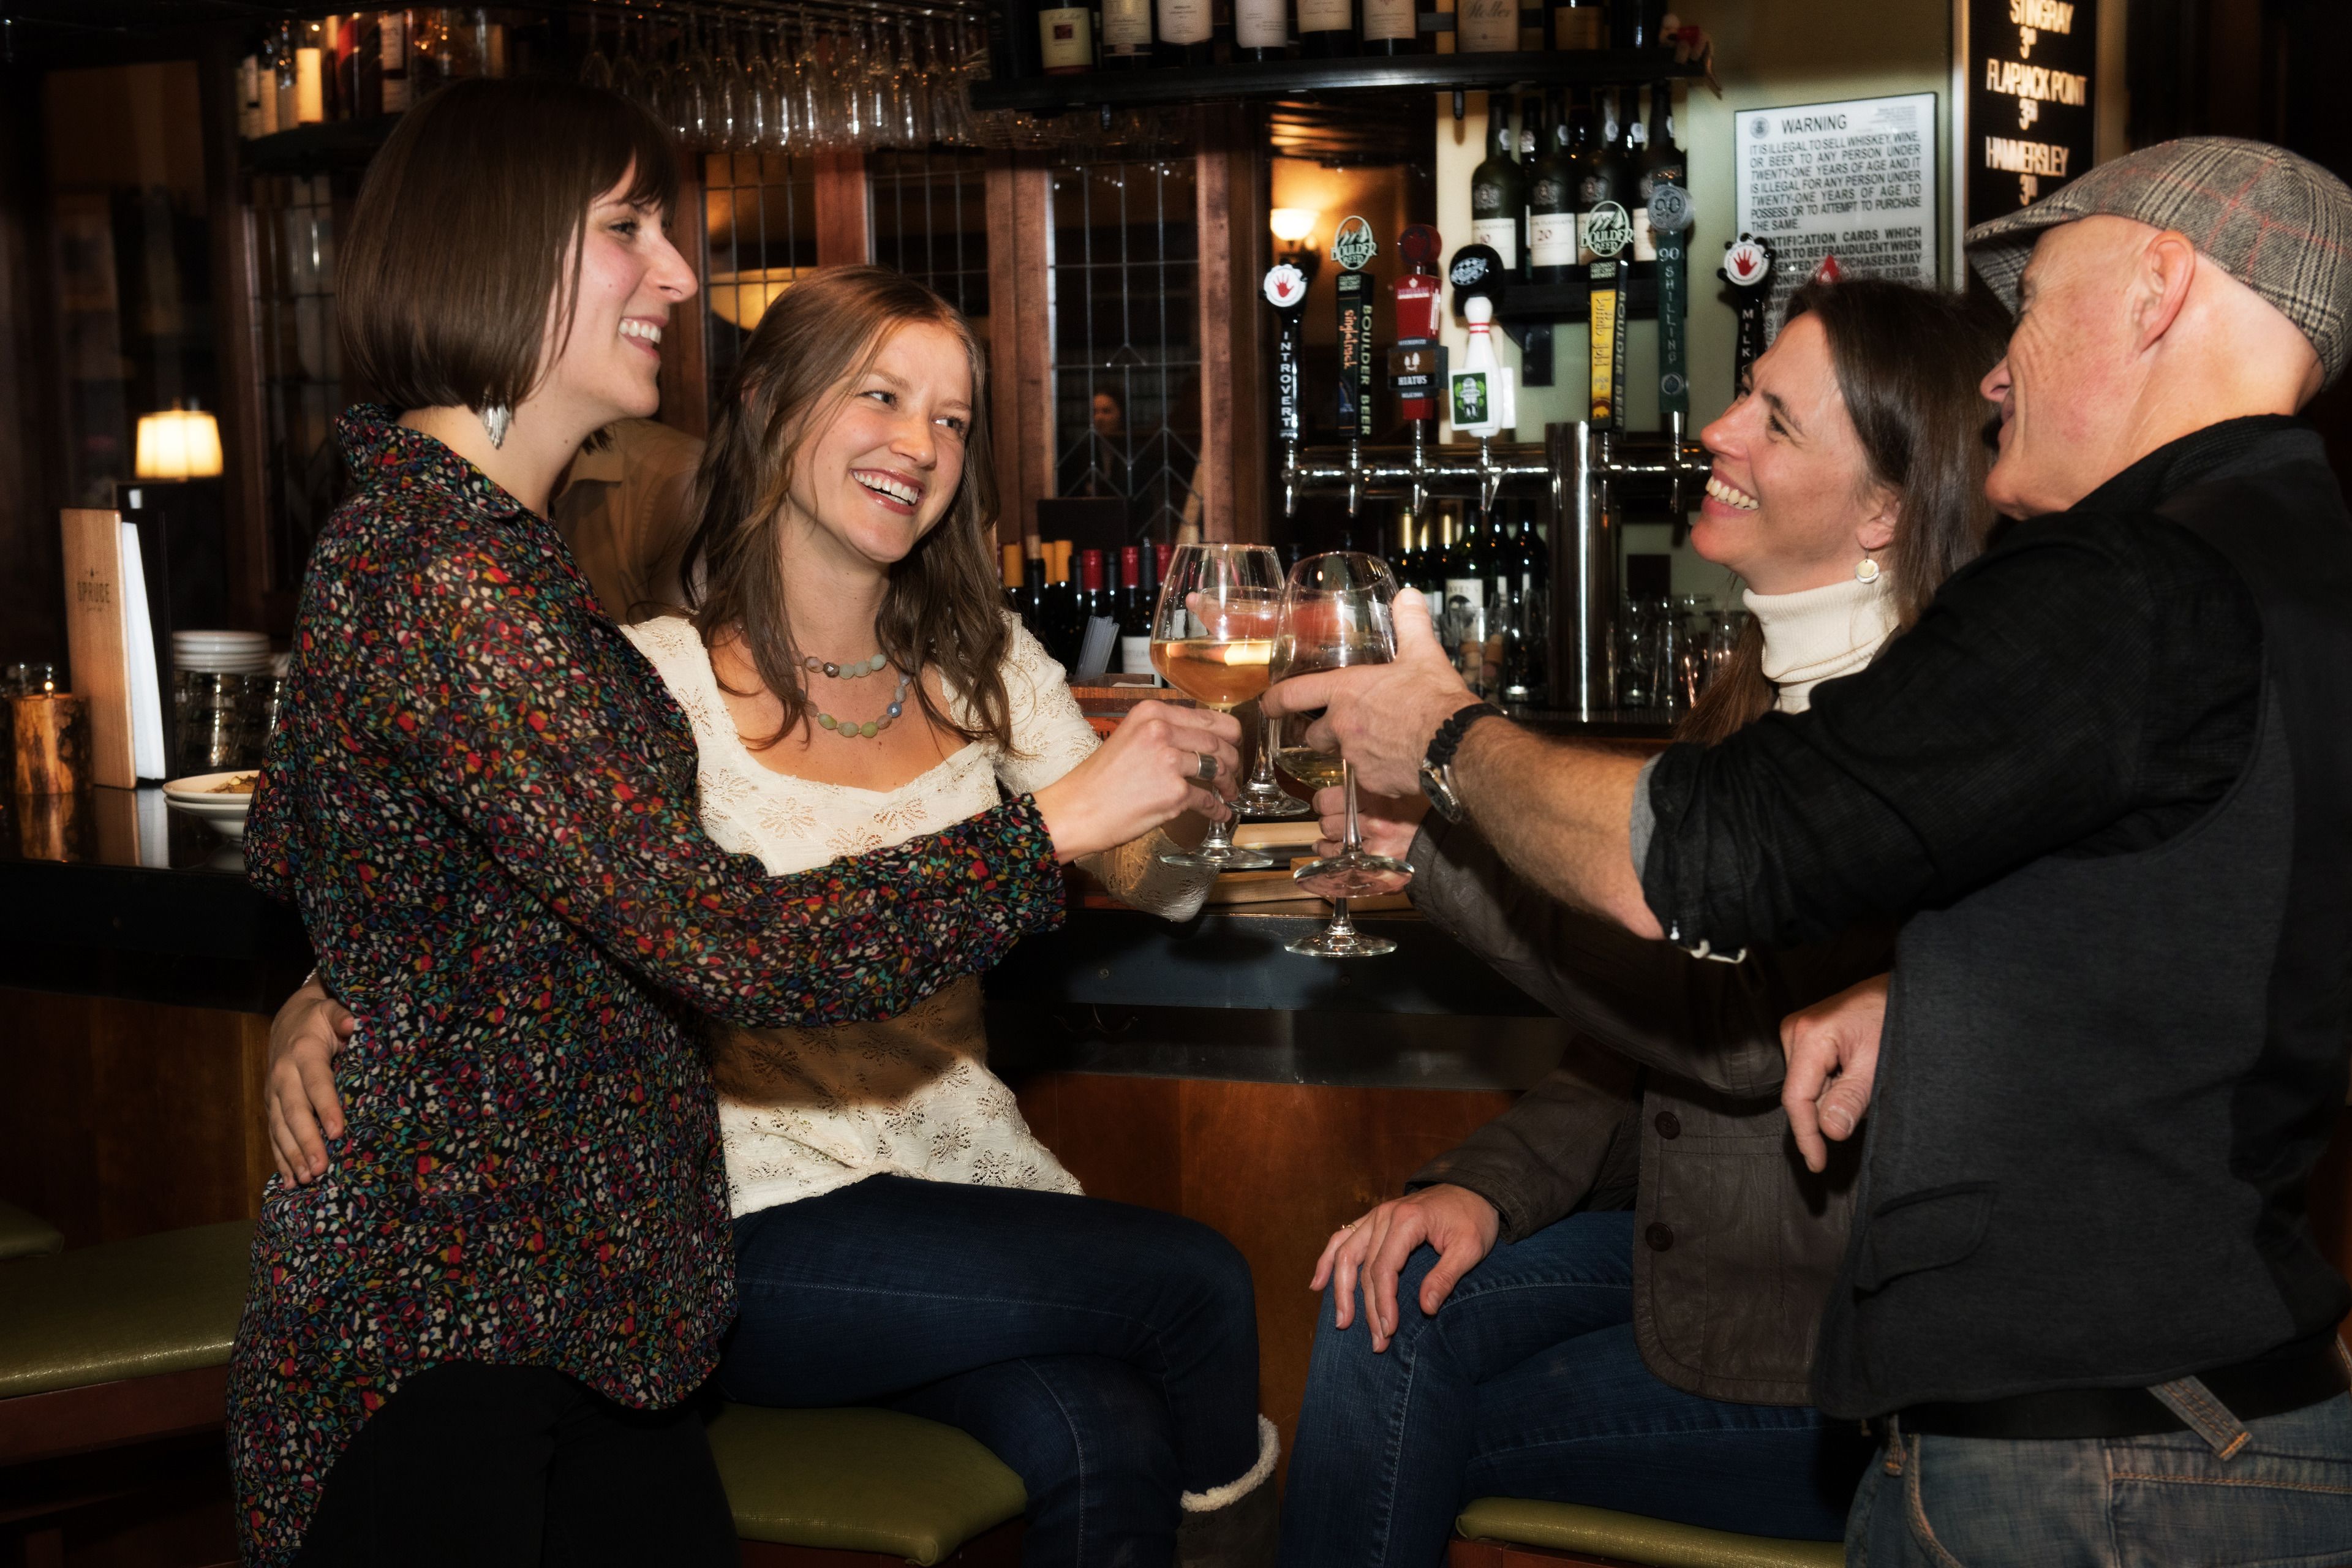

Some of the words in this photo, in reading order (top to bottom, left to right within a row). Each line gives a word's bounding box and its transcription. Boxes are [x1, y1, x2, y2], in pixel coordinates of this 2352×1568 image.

[2010, 0, 2075, 35] STINGRAY
[1986, 58, 2051, 100] FLAPJACK
[2050, 70, 2087, 107] POINT
[1781, 114, 1847, 134] WARNING
[1750, 145, 1757, 156] IT
[1758, 144, 1767, 155] IS
[1768, 141, 1807, 154] ILLEGAL
[1809, 140, 1821, 151] TO
[1822, 138, 1845, 149] SELL
[1750, 157, 1765, 168] OR
[1768, 154, 1794, 167] BEER
[1800, 153, 1812, 164] TO
[1817, 151, 1837, 162] ANY
[1842, 147, 1881, 160] PERSON
[1887, 143, 1921, 157] UNDER
[1985, 135, 2069, 178] HAMMERSLEY
[1751, 166, 1812, 182] TWENTY-ONE
[1817, 163, 1849, 176] YEARS
[1852, 161, 1863, 173] OF
[1866, 159, 1887, 172] AGE
[1889, 157, 1910, 169] AND
[1912, 156, 1921, 167] IT
[1751, 183, 1759, 194] IS
[1761, 180, 1800, 193] ILLEGAL
[1803, 178, 1822, 190] FOR
[1825, 176, 1842, 187] ANY
[1845, 173, 1885, 186] PERSON
[1887, 170, 1921, 183] UNDER
[1752, 191, 1816, 206] TWENTY-ONE
[1821, 188, 1855, 202] YEARS
[1861, 186, 1874, 198] OF
[1880, 184, 1901, 197] AGE
[1907, 183, 1921, 194] TO
[1655, 197, 1681, 216] 90
[1751, 206, 1789, 219] POSSESS
[1791, 205, 1804, 216] OR
[1807, 203, 1819, 216] TO
[1820, 200, 1857, 214] ATTEMPT
[1861, 199, 1873, 211] TO
[1875, 195, 1921, 210] PURCHASE
[1580, 227, 1634, 247] BOULDER
[1751, 220, 1769, 232] THE
[1842, 230, 1879, 243] CARDS
[1885, 226, 1921, 239] WHICH
[1330, 242, 1378, 262] BOULDER
[1594, 241, 1619, 254] BEER
[1659, 247, 1680, 262] 90
[1792, 247, 1806, 259] TO
[1807, 246, 1821, 258] BE
[1822, 241, 1888, 257] FRAUDULENT
[1890, 239, 1921, 252] WHEN
[1899, 252, 1921, 265] MAY
[1664, 265, 1677, 364] SHILLING
[1360, 304, 1373, 385] BOULDER
[1615, 291, 1627, 375] BOULDER
[1741, 309, 1754, 357] MILK
[1280, 331, 1292, 427] INTROVERT
[1397, 374, 1428, 386] HIATUS
[1360, 394, 1371, 435] BEER
[1615, 384, 1624, 428] BEER
[77, 581, 110, 603] SPRUCE
